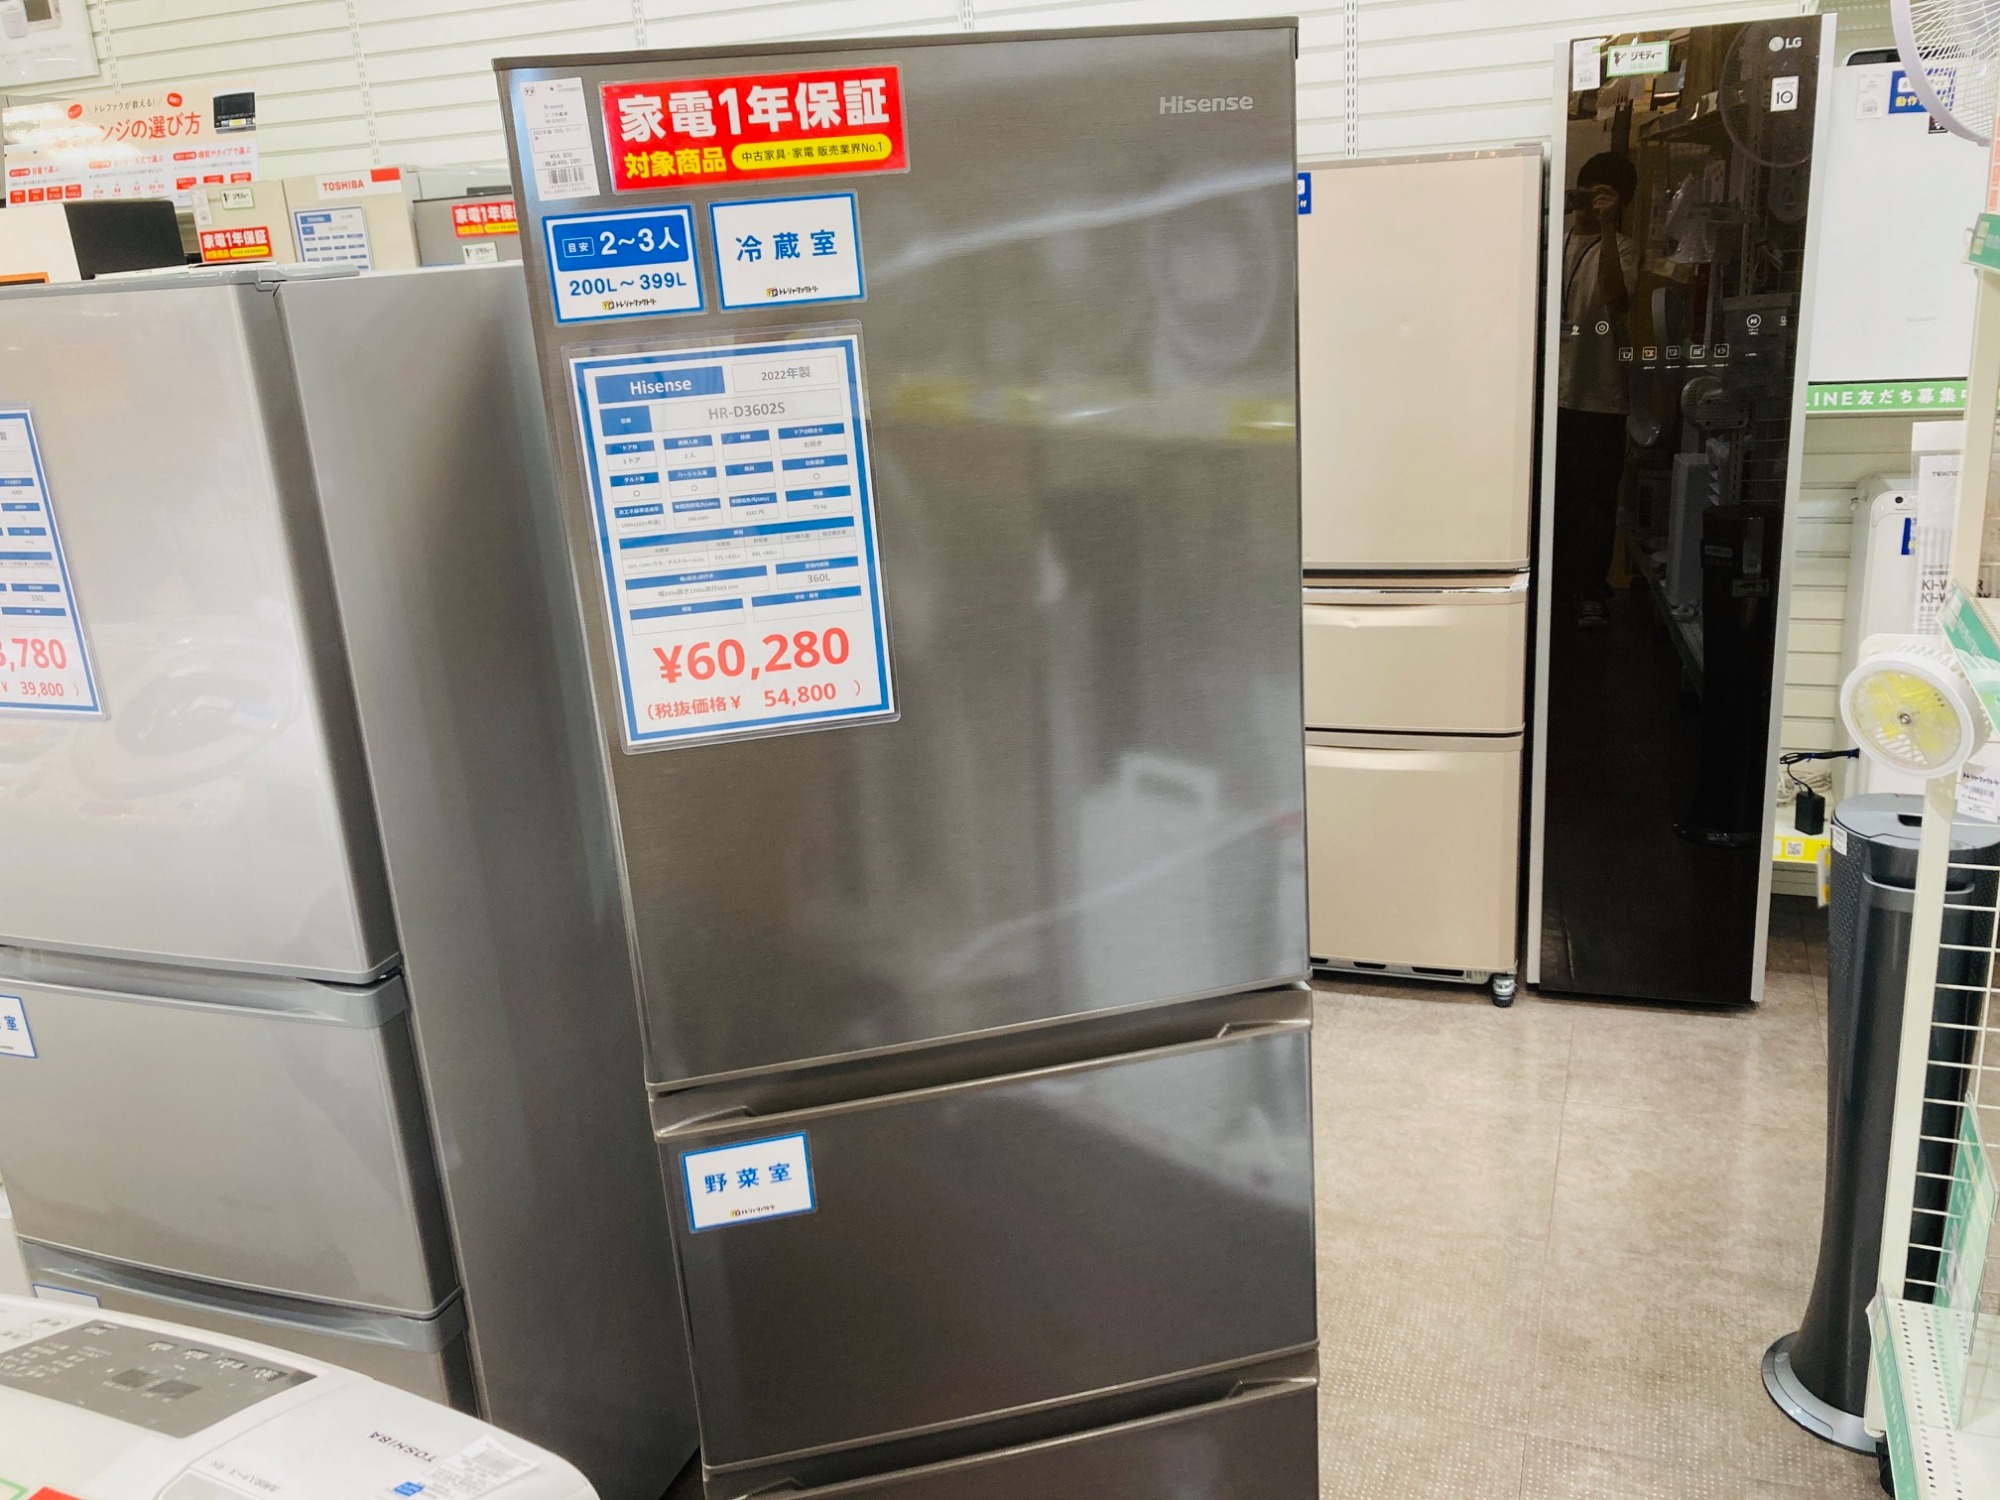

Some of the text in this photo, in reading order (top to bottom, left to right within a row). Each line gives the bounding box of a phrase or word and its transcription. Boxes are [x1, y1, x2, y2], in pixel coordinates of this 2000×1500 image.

[1785, 36, 1802, 49] LG
[617, 78, 890, 143] 家電1年保証
[1159, 95, 1254, 115] Hisense
[623, 147, 727, 179] 対象商品
[817, 141, 884, 158] 販売業界No.1
[322, 180, 365, 192] TOSHIBA
[454, 203, 516, 224] 家電1年保
[567, 241, 590, 254] 目安
[735, 229, 838, 263] 冷蔵室
[760, 365, 812, 381] 2022年製
[629, 377, 692, 396] Hisense
[1806, 387, 1968, 407] INE友だち募集
[708, 402, 786, 421] HR-D3602S
[807, 573, 831, 584] 360L
[652, 627, 850, 685] ¥60,280
[20, 681, 64, 698] 39,800
[763, 682, 837, 709] 54,800
[704, 1162, 792, 1194] 野菜室
[368, 1431, 437, 1464] TOSHIBA
